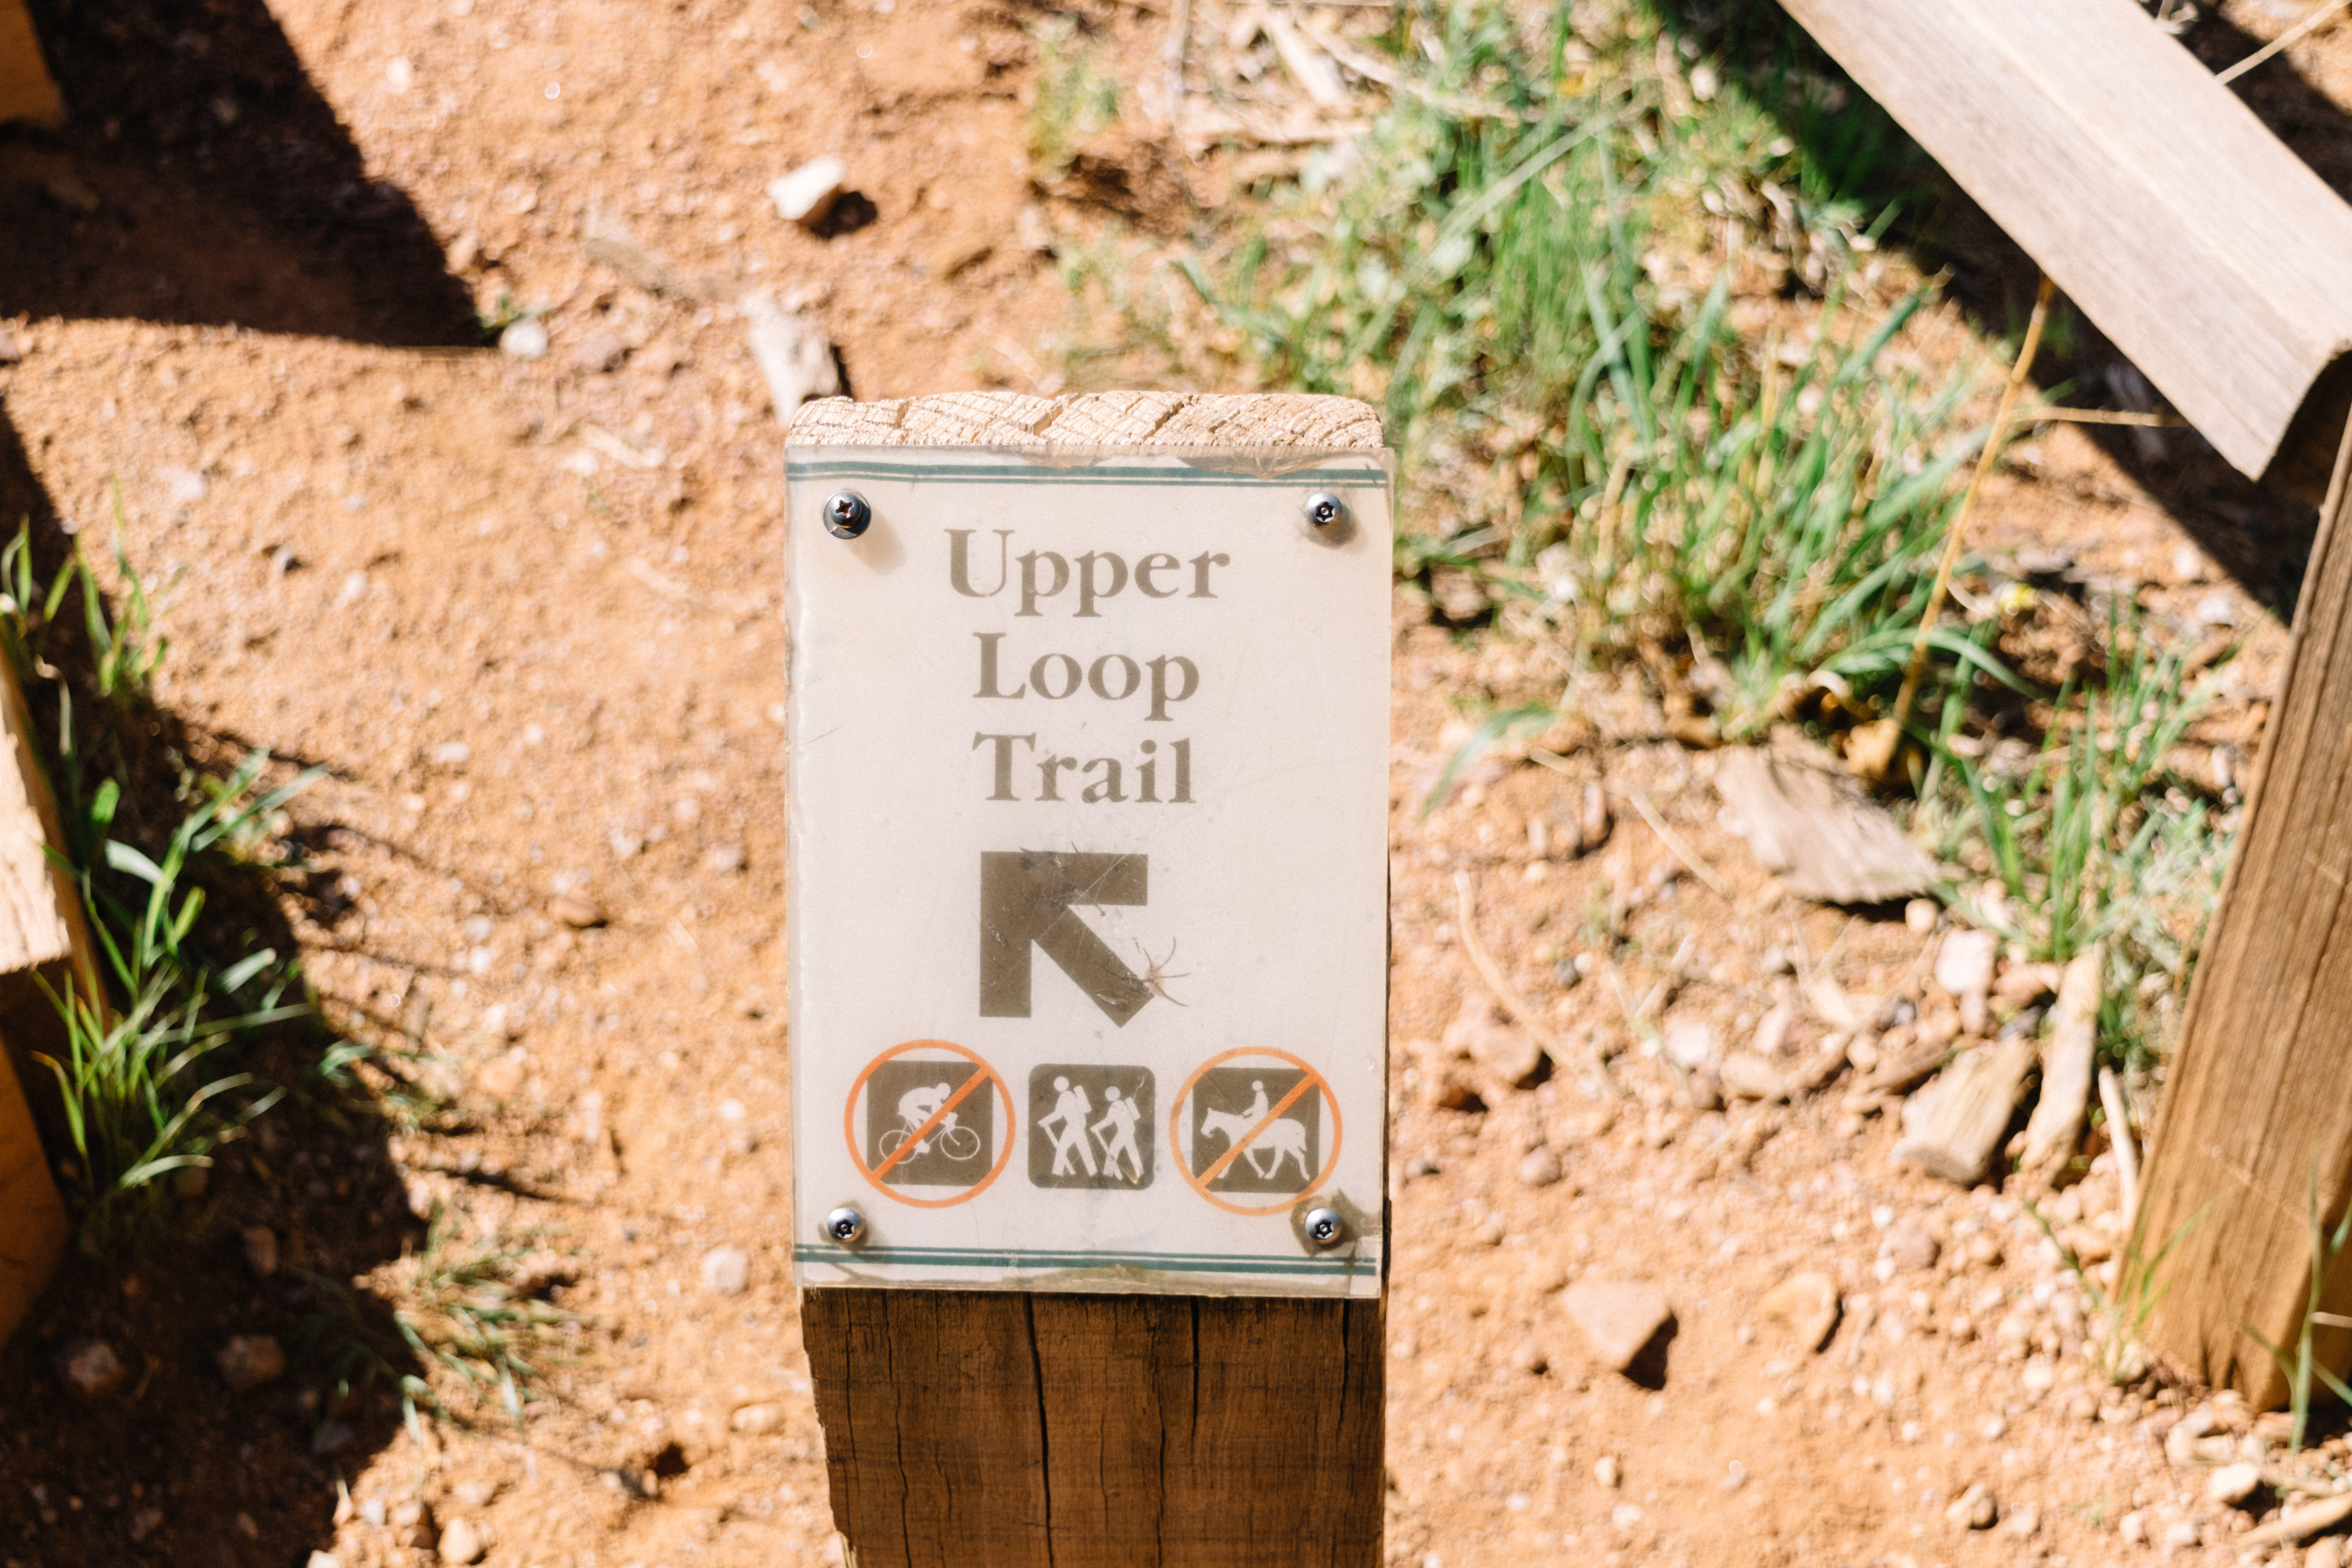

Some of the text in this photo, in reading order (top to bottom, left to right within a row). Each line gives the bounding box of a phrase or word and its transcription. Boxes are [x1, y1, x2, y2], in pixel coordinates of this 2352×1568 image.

[944, 529, 1230, 617] Upper
[972, 632, 1200, 722] Loop
[972, 731, 1197, 804] Trail
